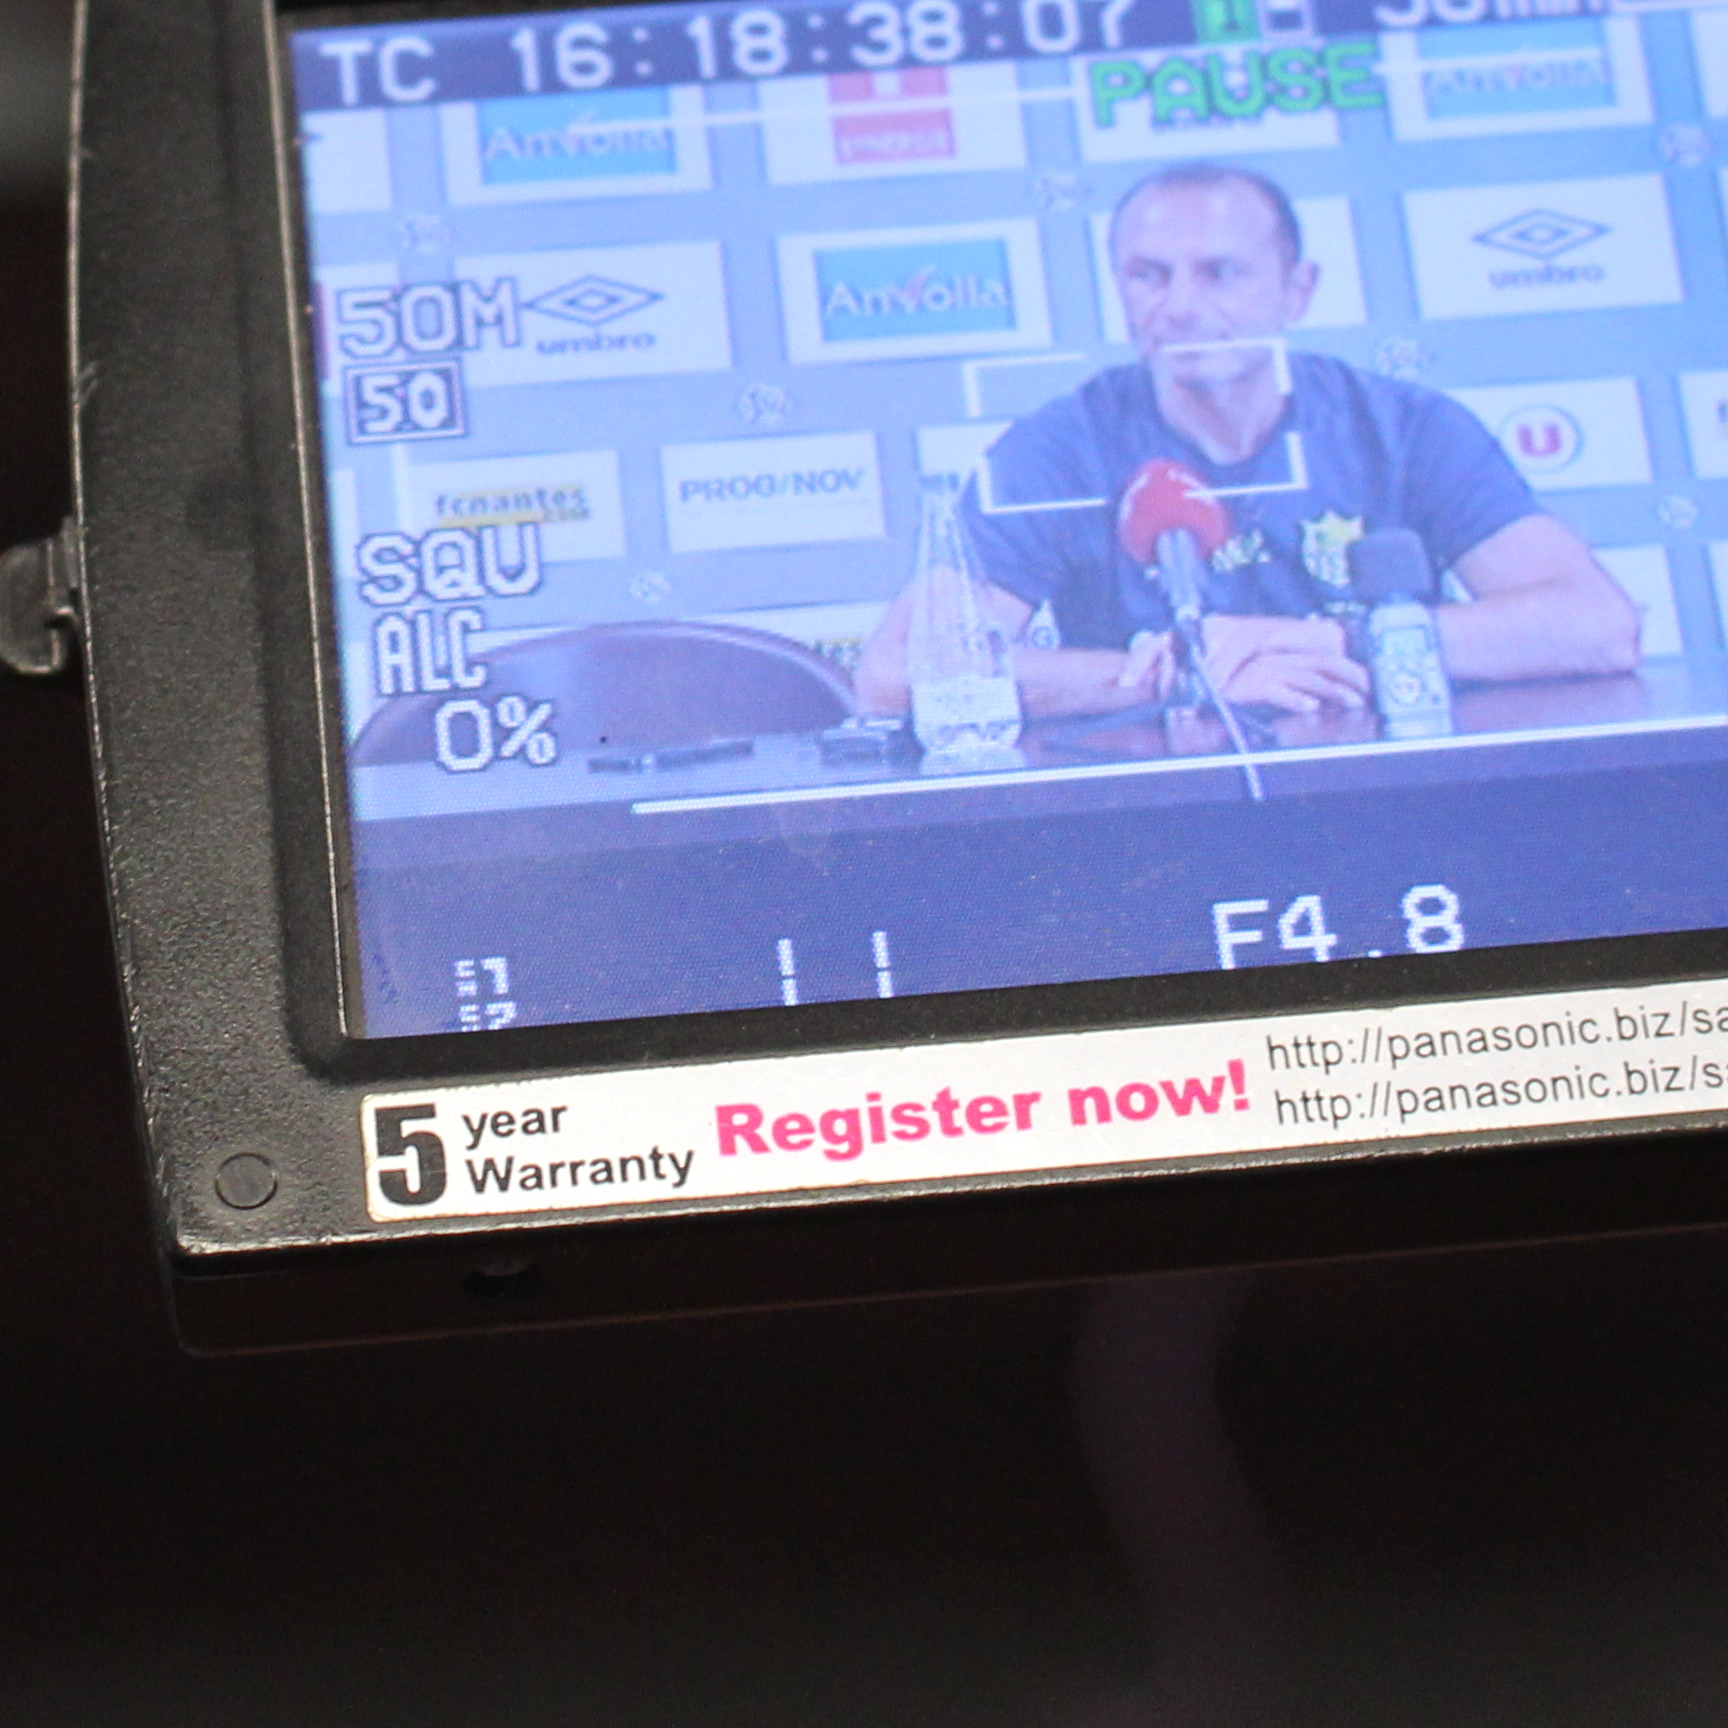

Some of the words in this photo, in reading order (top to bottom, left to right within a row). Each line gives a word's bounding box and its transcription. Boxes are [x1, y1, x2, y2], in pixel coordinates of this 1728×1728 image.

[321, 38, 436, 106] TC
[1088, 41, 1384, 129] PAUSE
[535, 331, 657, 356] umbro
[375, 604, 488, 696] ALC
[434, 694, 558, 773] 0%
[462, 1104, 569, 1151] year
[715, 1086, 1043, 1162] Register
[1067, 1057, 1251, 1128] now!
[373, 1102, 448, 1208] 5
[465, 1145, 696, 1196] Warranty
